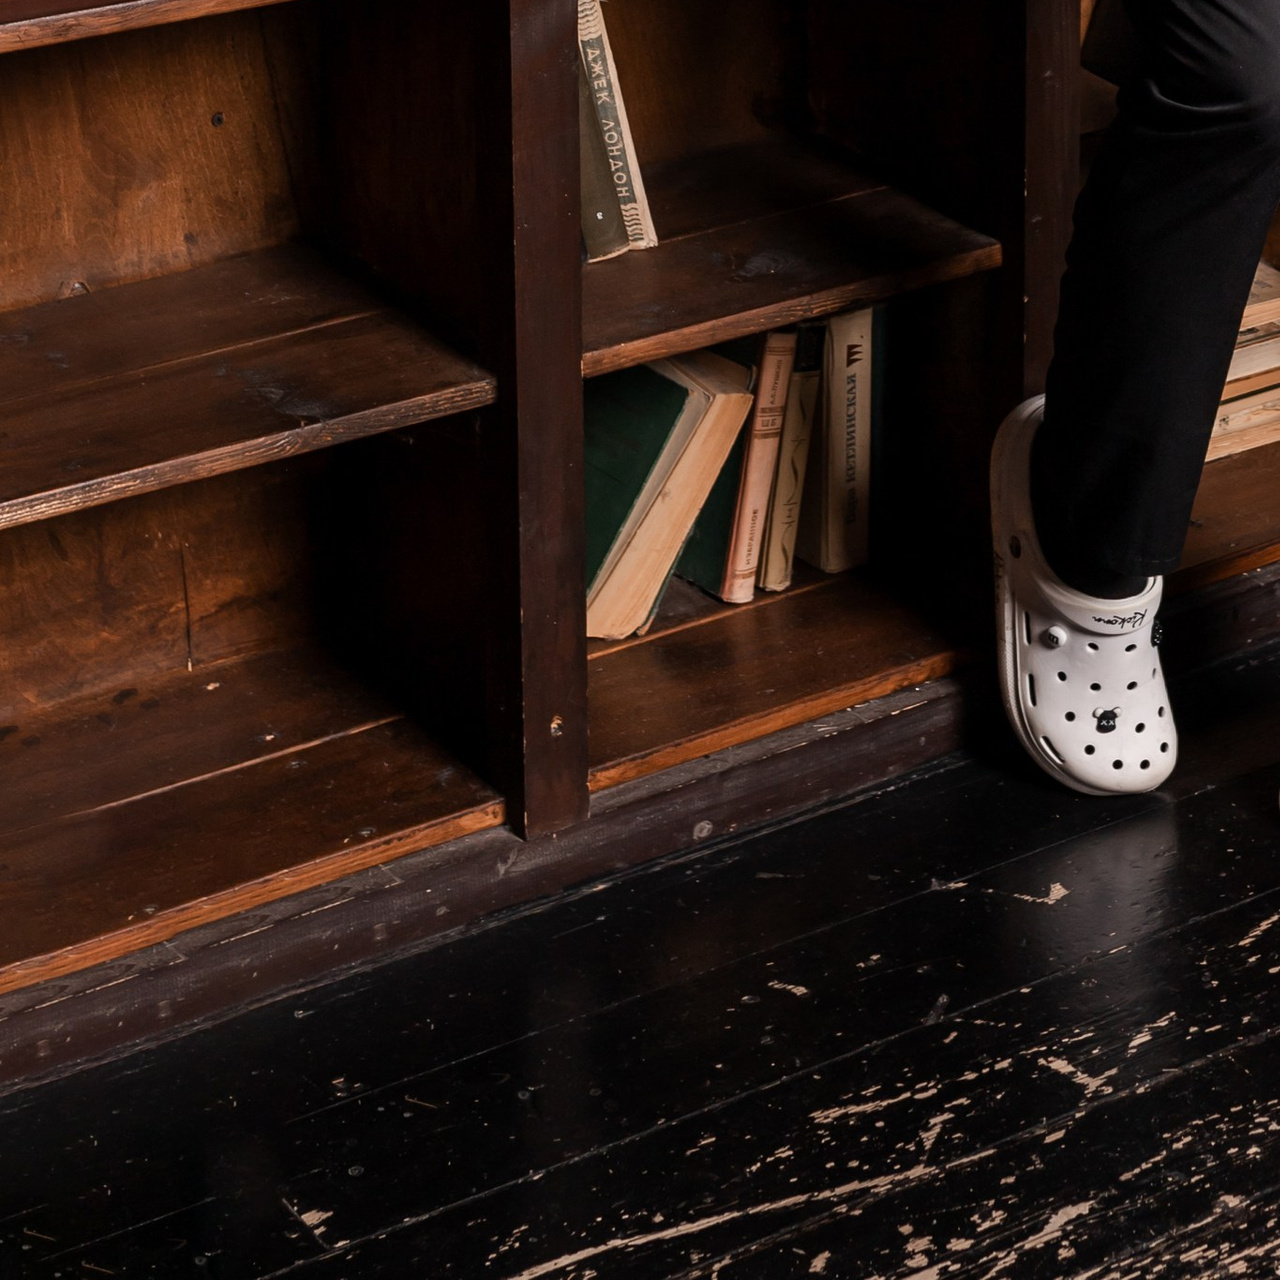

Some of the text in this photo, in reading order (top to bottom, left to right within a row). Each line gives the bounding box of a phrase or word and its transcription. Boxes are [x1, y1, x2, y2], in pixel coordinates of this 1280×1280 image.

[587, 46, 631, 200] ДЖЕК ЛОНДОН
[844, 371, 858, 484] КЕТЛИНСКАЯ
[744, 507, 760, 568] ИЗБРАННОЕ
